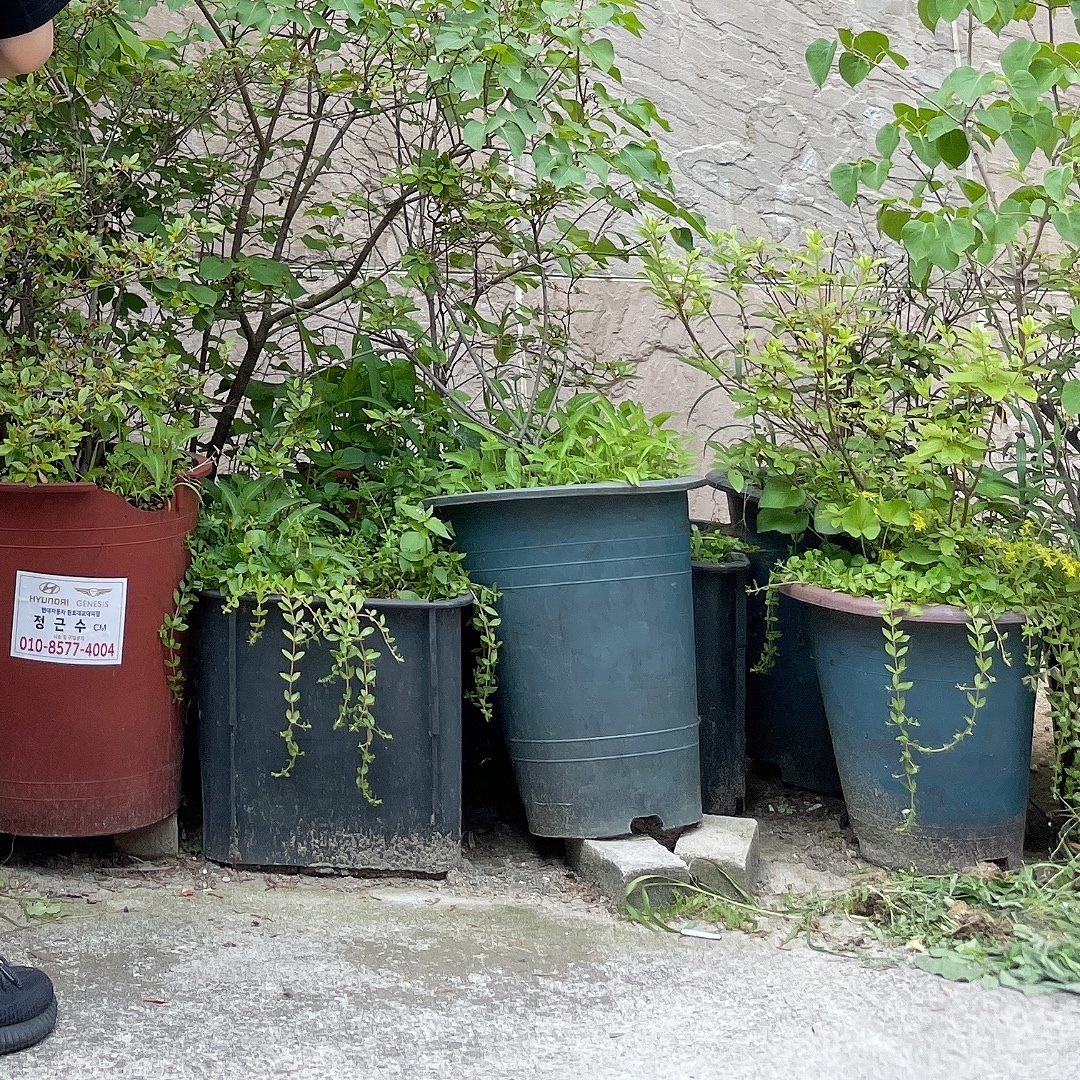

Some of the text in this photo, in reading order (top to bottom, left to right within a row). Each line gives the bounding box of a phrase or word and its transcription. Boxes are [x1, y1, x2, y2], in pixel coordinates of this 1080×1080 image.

[29, 595, 109, 608] HYUNDAI GENESIS
[93, 623, 107, 632] CM
[20, 636, 115, 657] 010-8577-4004
